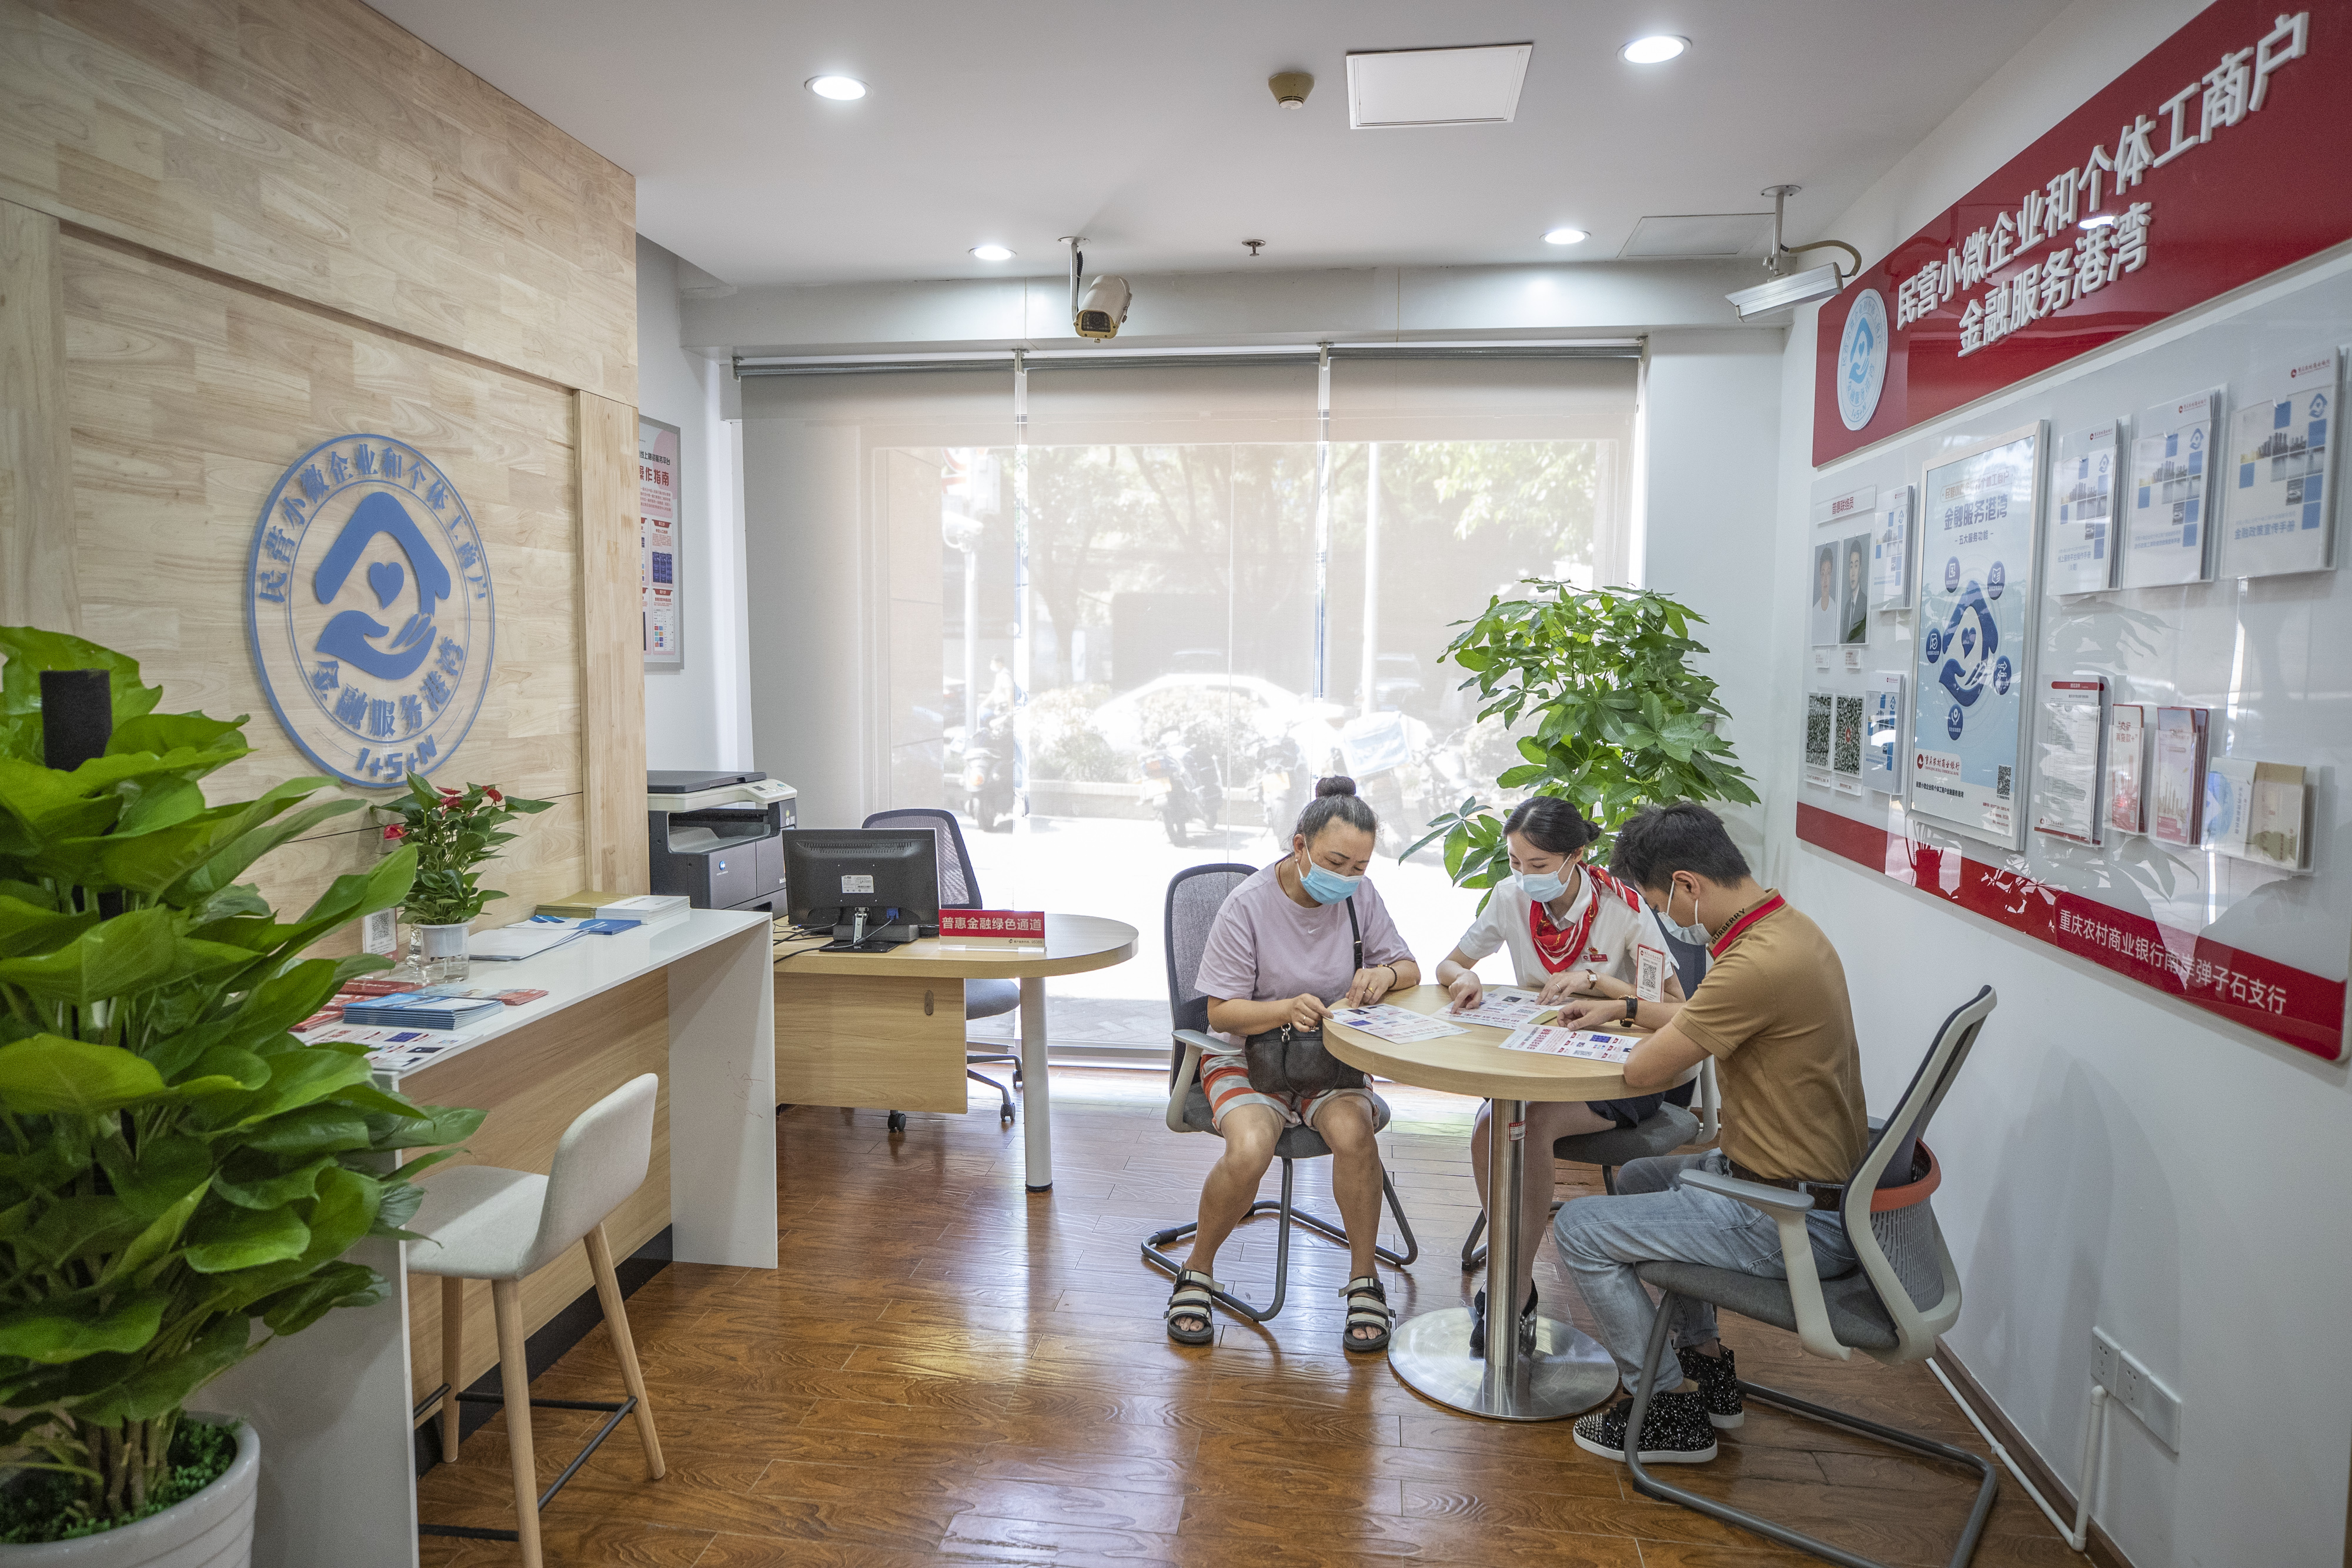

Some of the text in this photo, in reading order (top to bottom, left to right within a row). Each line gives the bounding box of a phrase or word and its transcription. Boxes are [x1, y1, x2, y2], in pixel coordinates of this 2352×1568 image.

[1896, 11, 2310, 332] 民营小微企业和个体工商户
[1958, 200, 2152, 358] 金融服务港湾
[639, 450, 670, 466] 线上融资服务平台
[259, 444, 486, 604] 民营小微企业和个体工商户
[1832, 496, 1854, 515] 普惠联络员
[1944, 493, 2009, 530] 金融服务港湾
[1953, 530, 1989, 545] 五大服务功能
[309, 635, 465, 737] 金融服务港湾
[942, 917, 1042, 931] 普惠金融绿色通道
[1711, 908, 1745, 945] BURBERRY
[2059, 908, 2287, 1015] 重庆农村商业银行南岸弹子石支行
